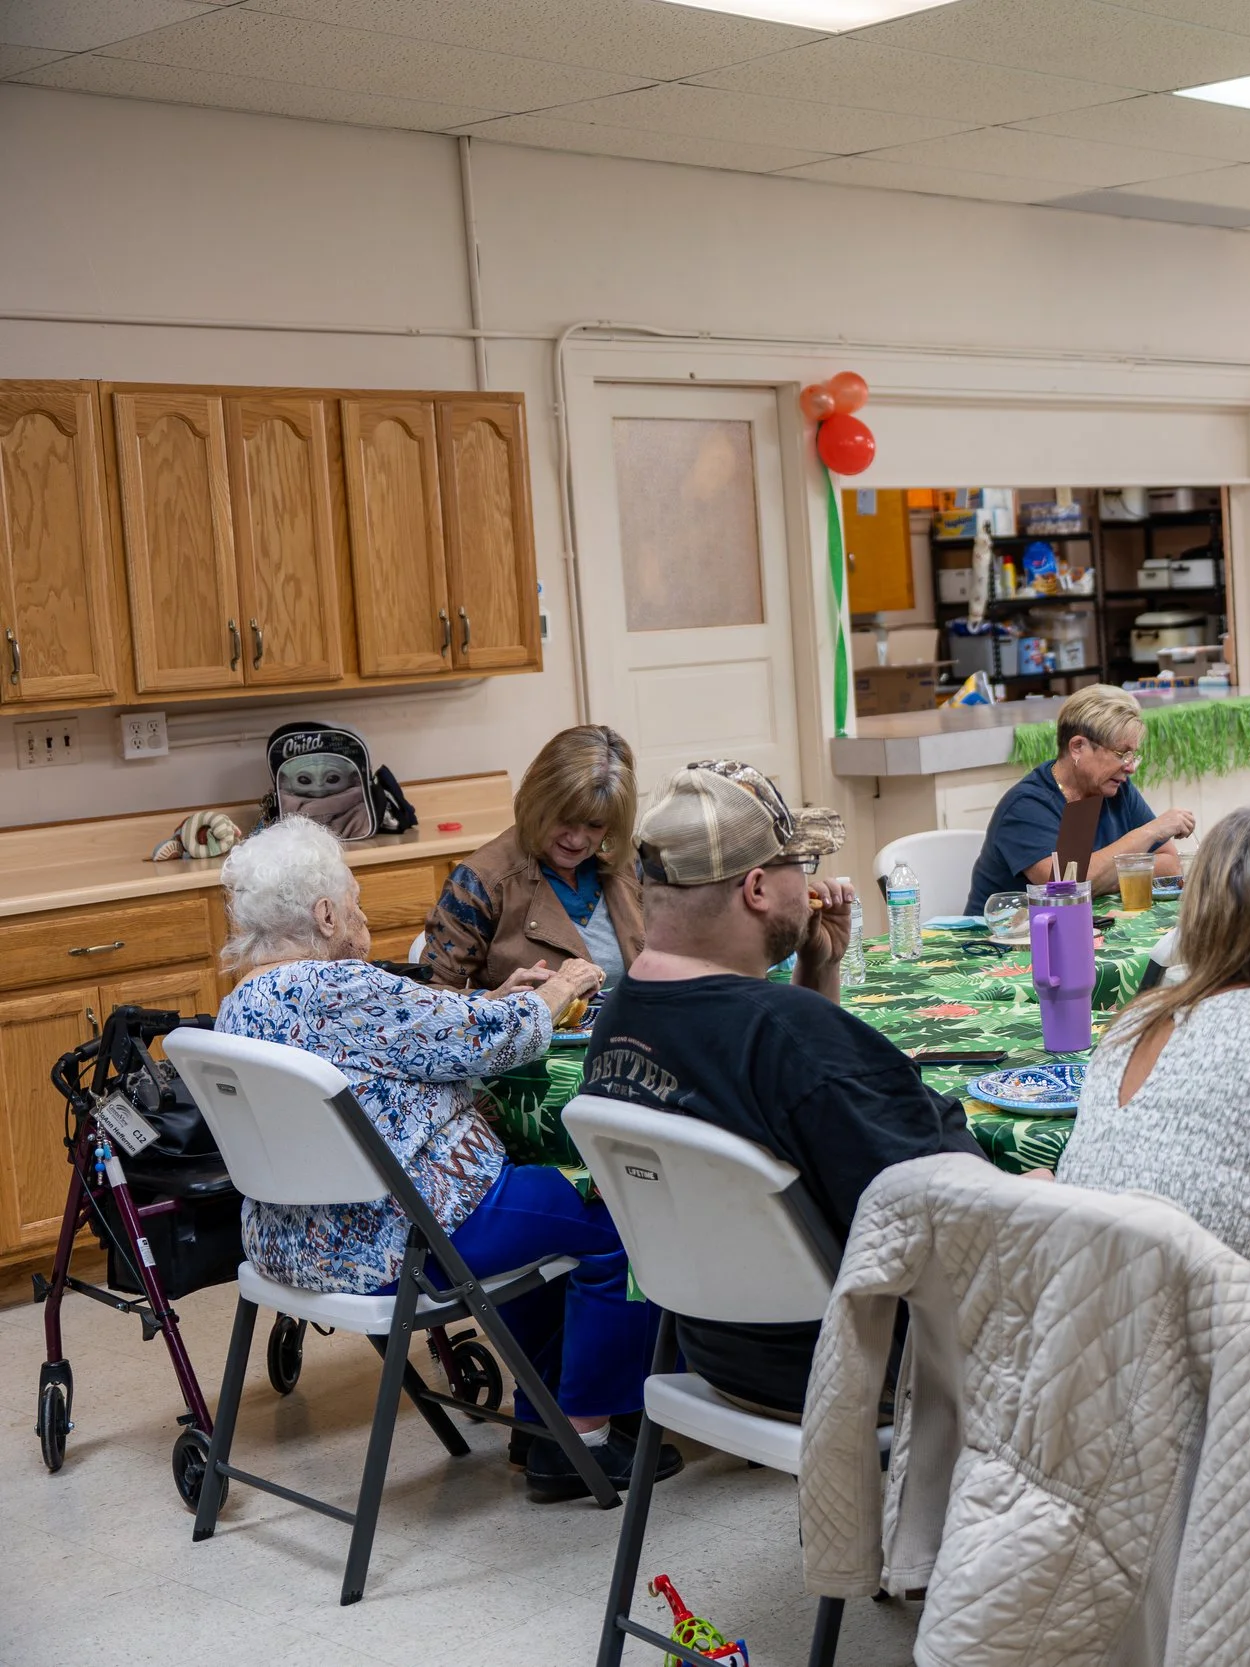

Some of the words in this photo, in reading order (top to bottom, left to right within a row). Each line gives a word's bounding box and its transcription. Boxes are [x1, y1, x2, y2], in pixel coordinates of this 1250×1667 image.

[282, 734, 324, 759] Child
[587, 1049, 679, 1102] BETTER
[112, 1126, 136, 1152] Heffernan
[132, 1129, 147, 1144] C12
